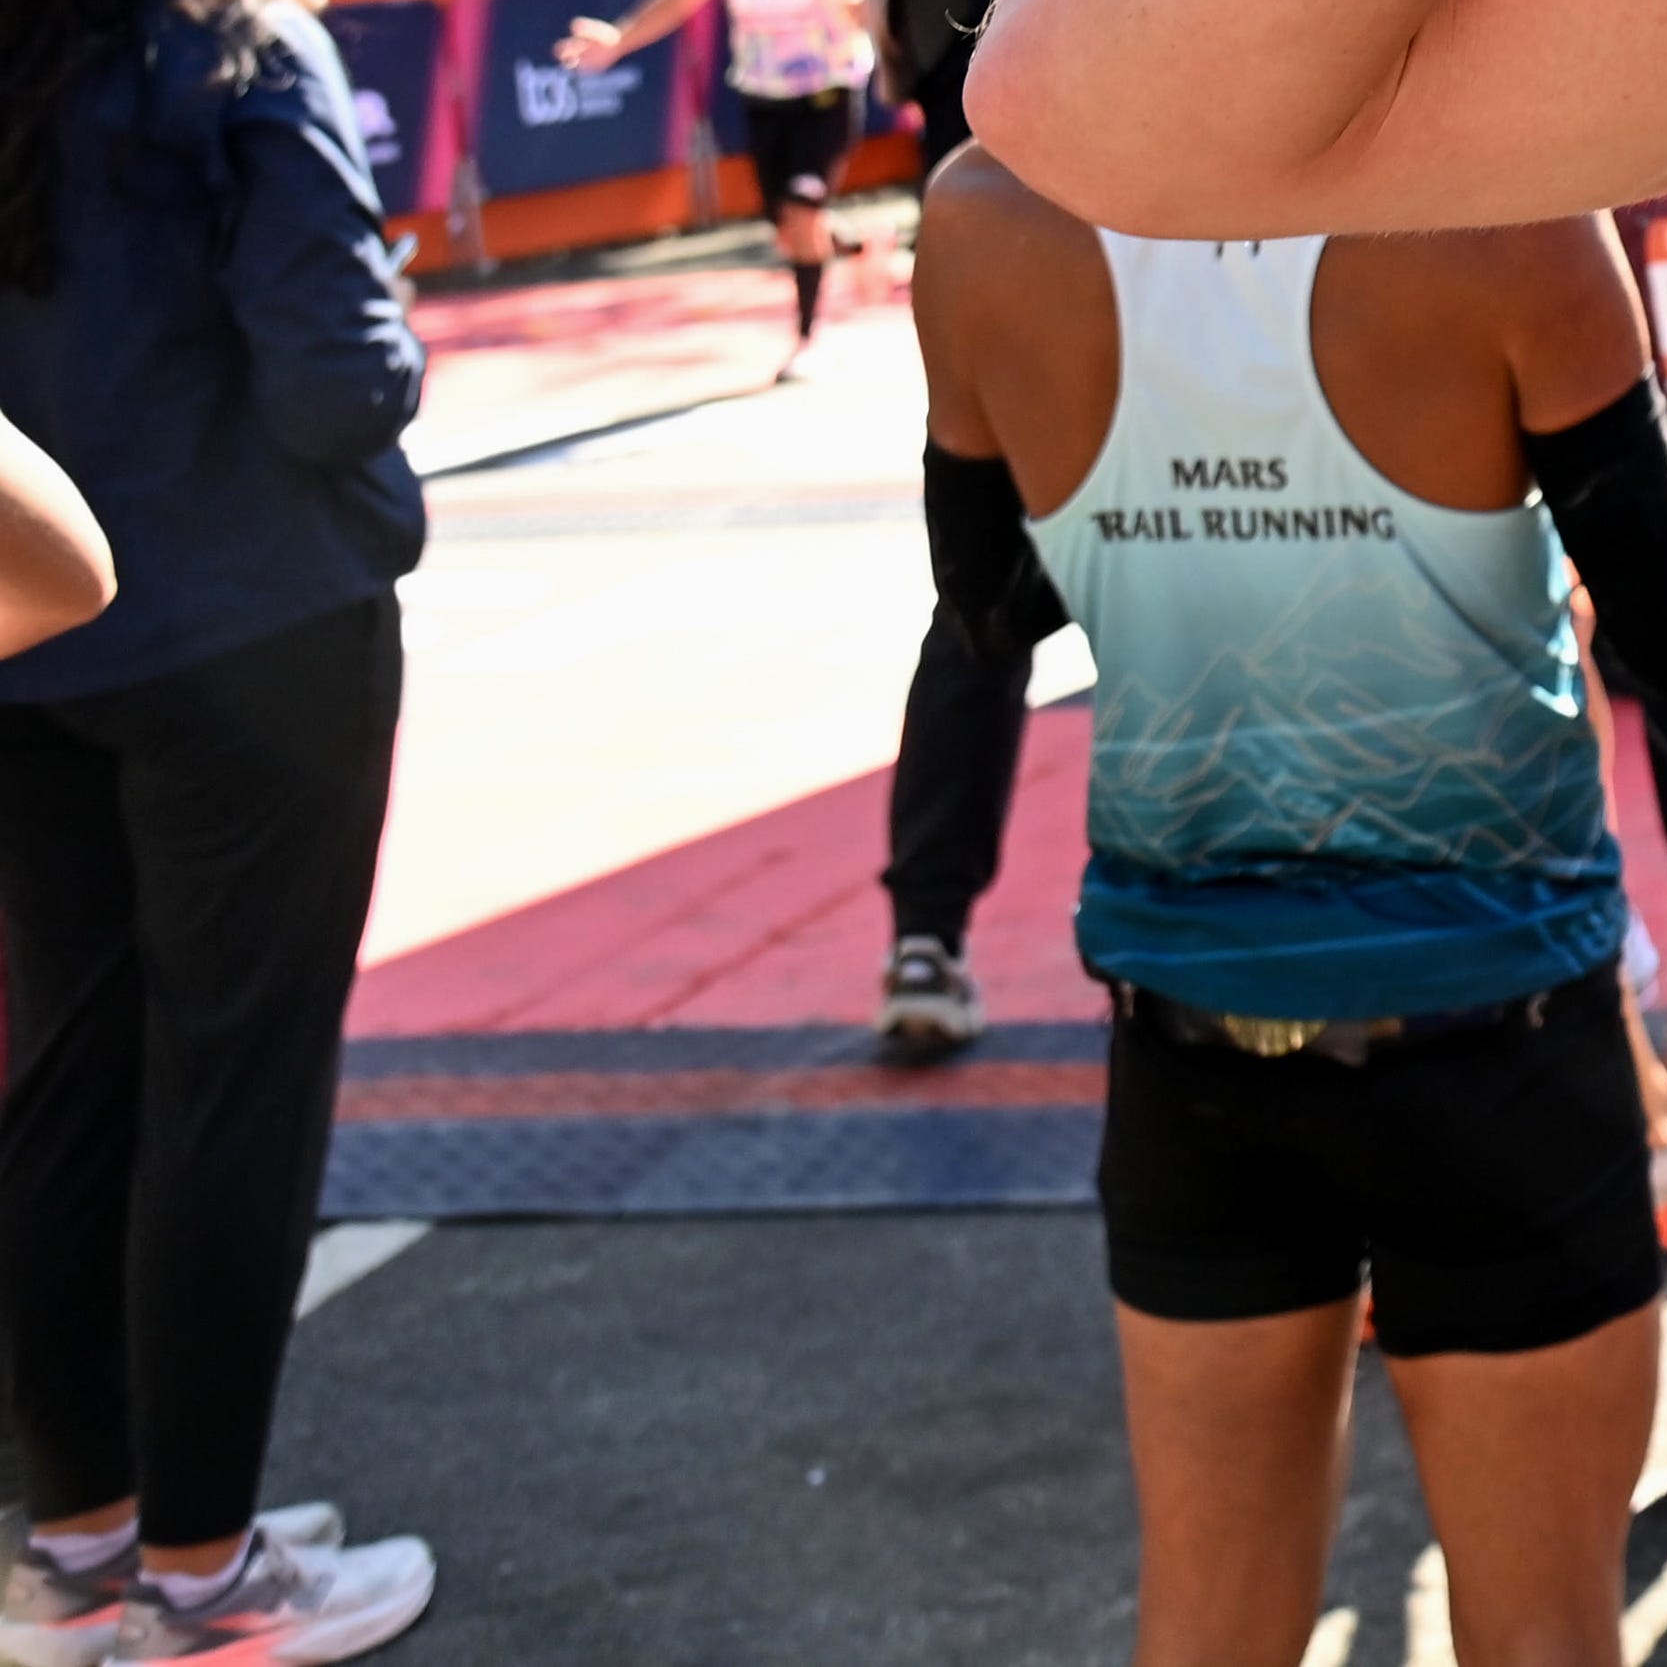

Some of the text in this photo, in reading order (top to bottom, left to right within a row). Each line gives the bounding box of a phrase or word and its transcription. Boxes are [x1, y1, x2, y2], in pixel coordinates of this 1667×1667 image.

[1171, 457, 1288, 491] MARS
[1092, 505, 1396, 543] TRAIL RUNNING
